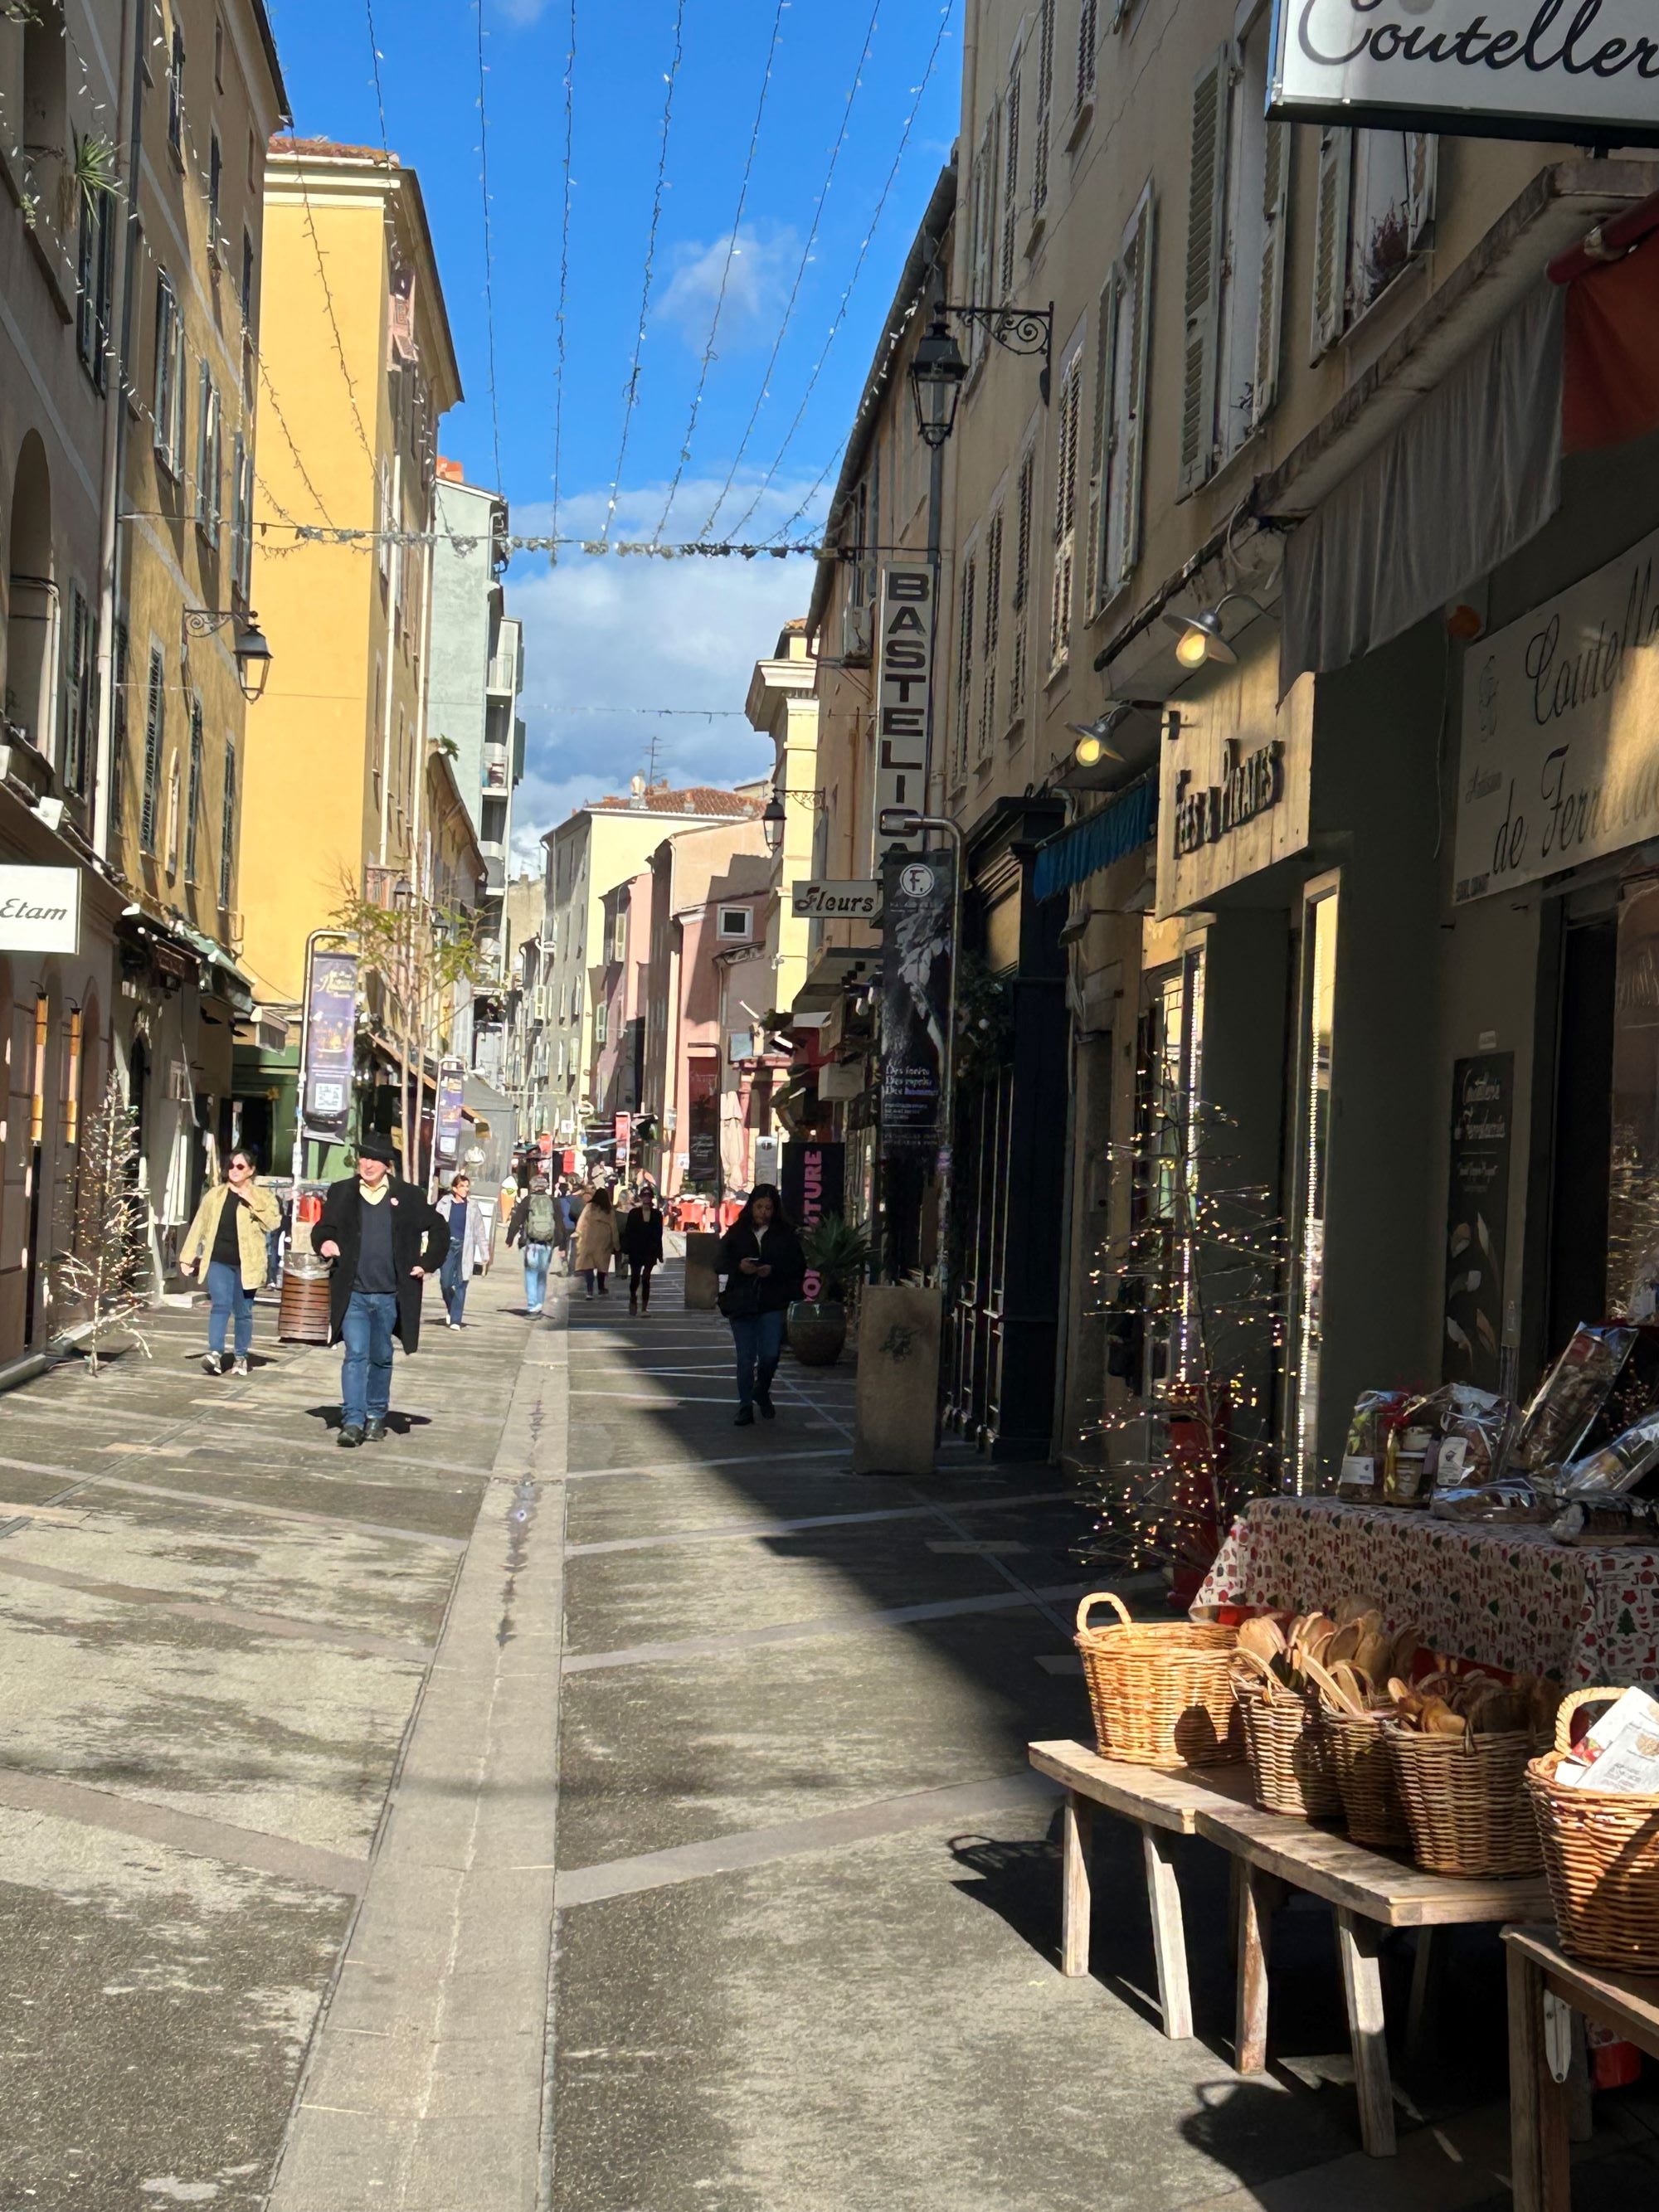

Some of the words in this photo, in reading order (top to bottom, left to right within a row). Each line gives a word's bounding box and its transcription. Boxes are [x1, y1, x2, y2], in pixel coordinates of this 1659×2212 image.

[1493, 777, 1528, 875] de
[0, 897, 68, 921] Etam
[795, 886, 873, 912] Fleurs
